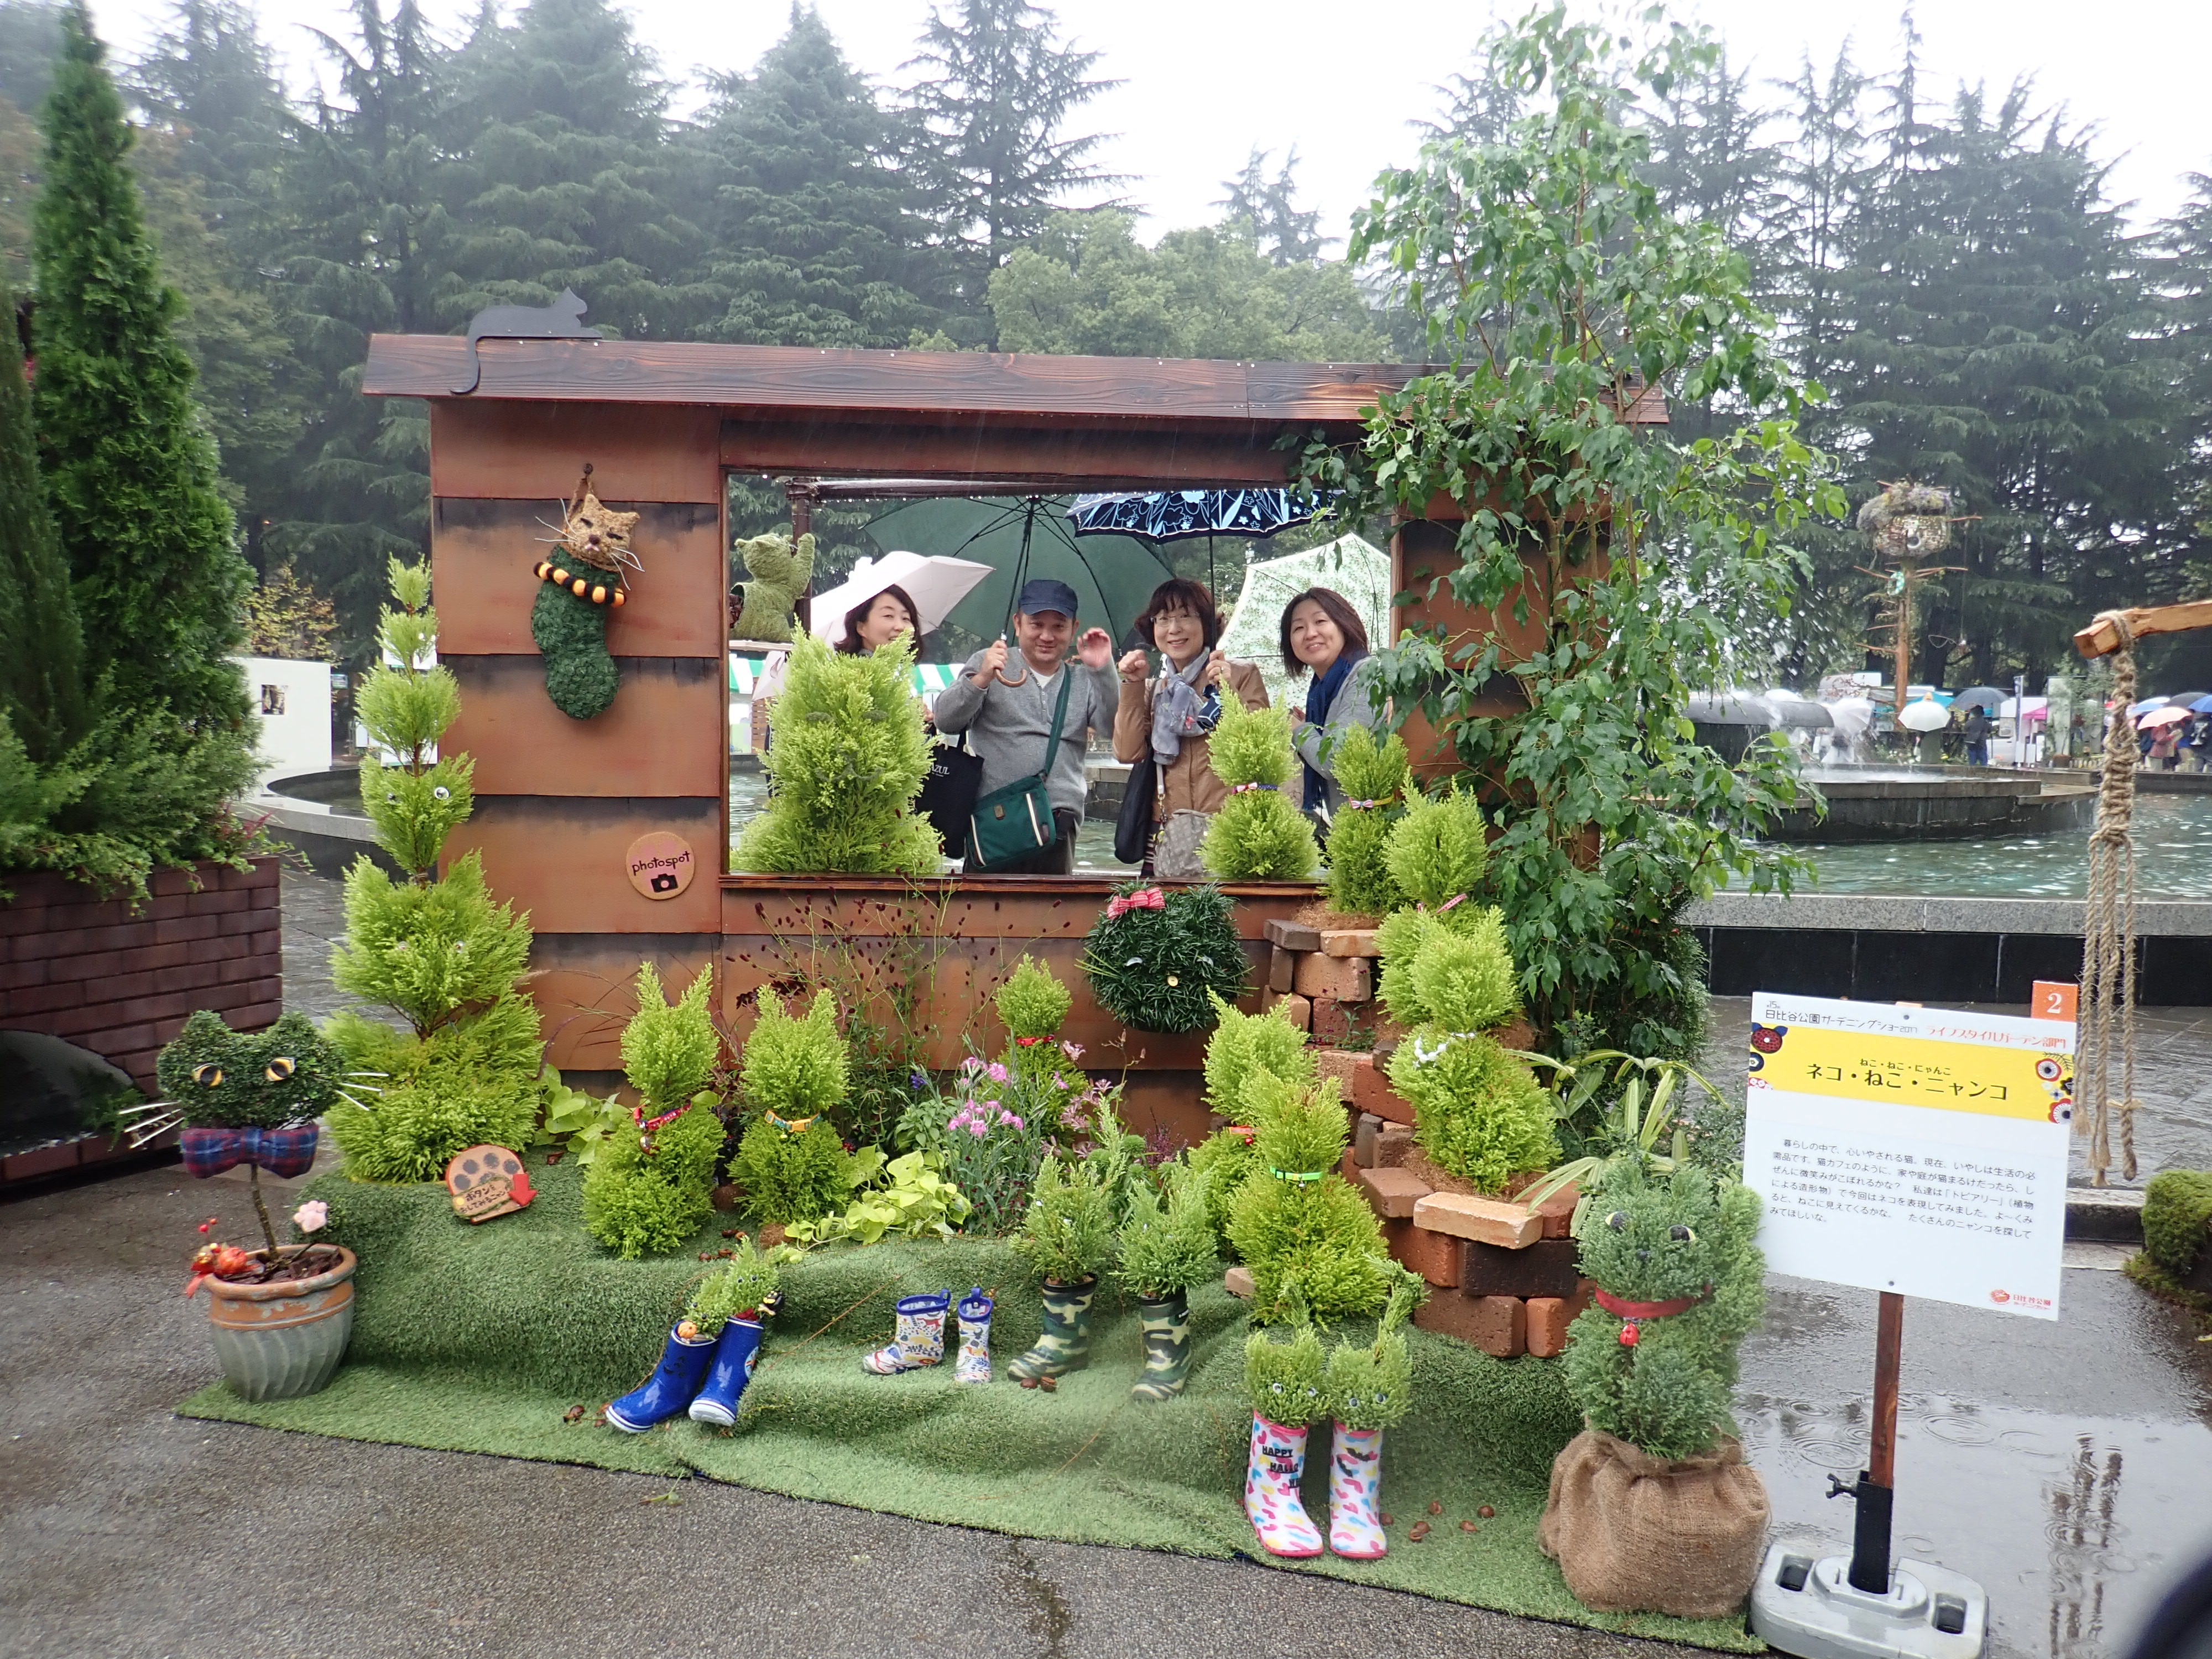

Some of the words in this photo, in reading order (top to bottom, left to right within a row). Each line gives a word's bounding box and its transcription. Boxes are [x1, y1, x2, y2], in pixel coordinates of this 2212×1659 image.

[632, 851, 690, 876] photospot
[2047, 993, 2062, 1014] 2
[1262, 1445, 1293, 1457] HAPPY
